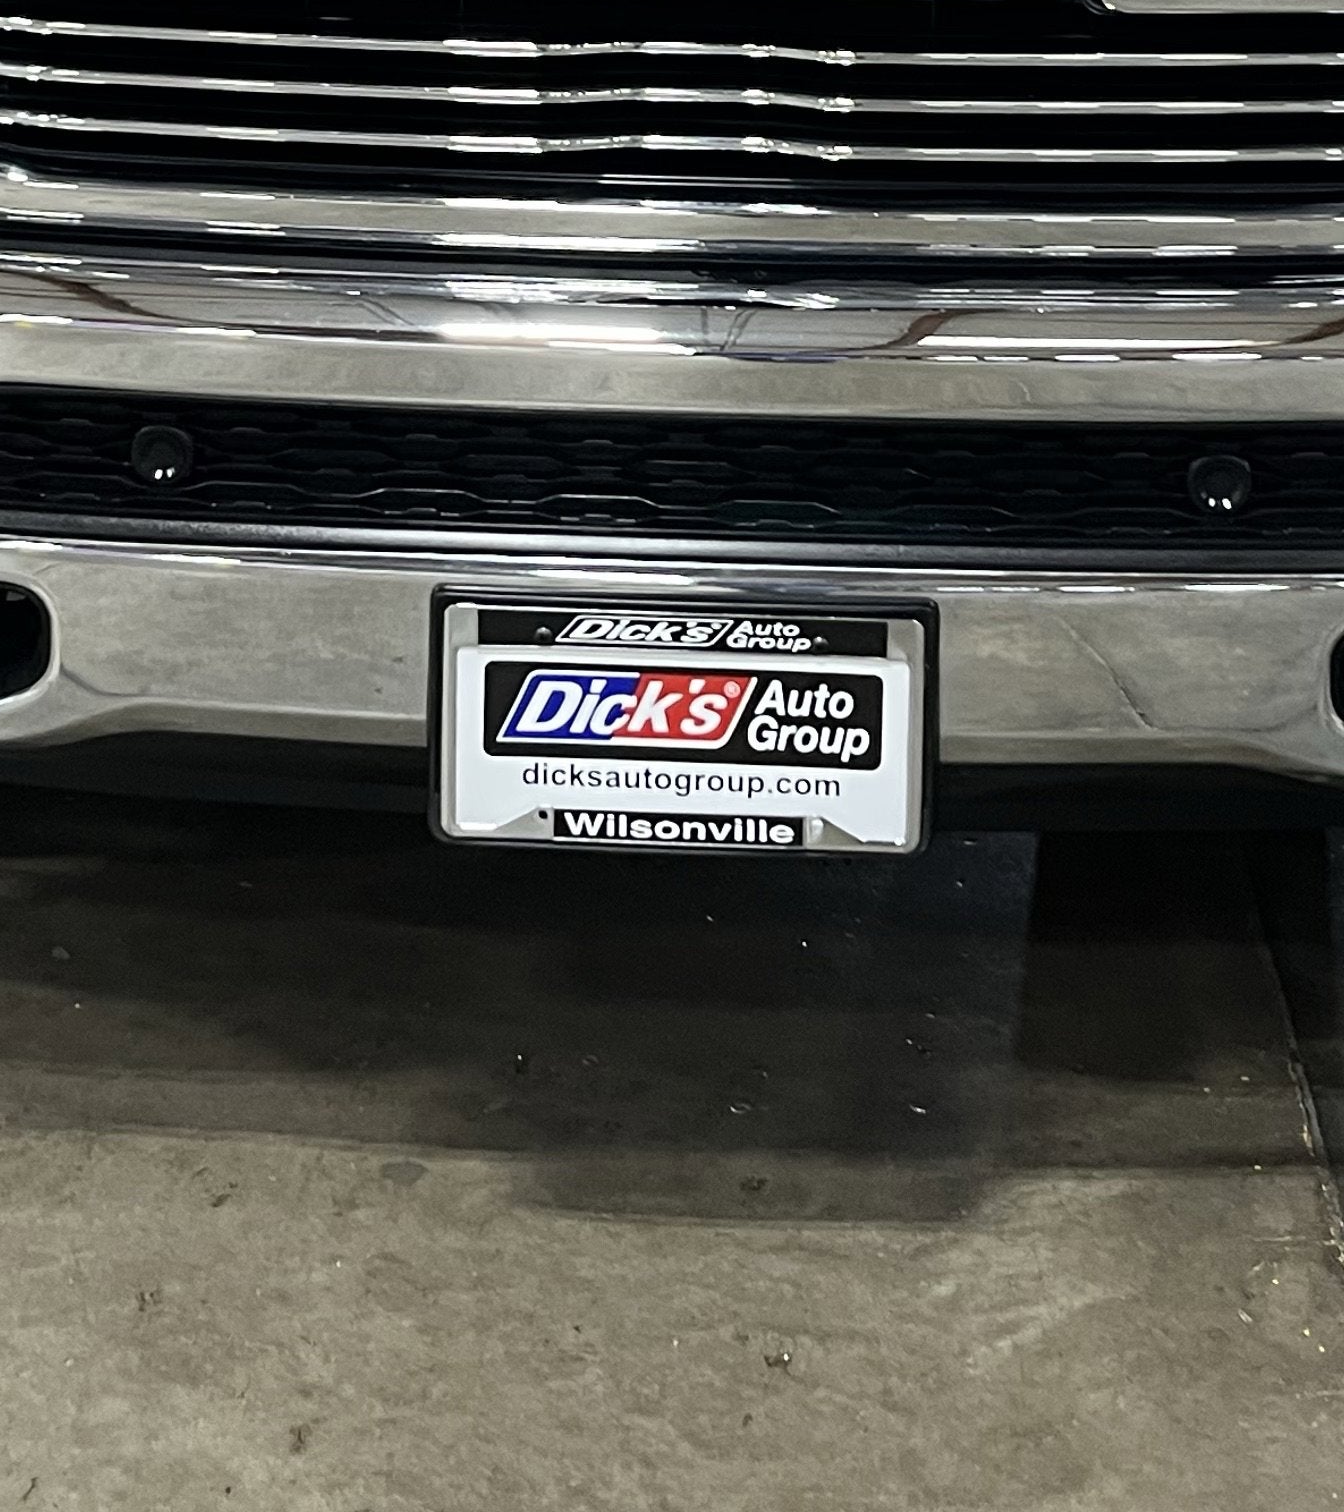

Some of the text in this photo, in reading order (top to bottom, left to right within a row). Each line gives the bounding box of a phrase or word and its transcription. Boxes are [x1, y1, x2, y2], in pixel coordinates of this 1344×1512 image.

[568, 619, 716, 643] Dick's
[726, 633, 812, 653] Group
[733, 620, 801, 637] Auto
[515, 678, 729, 736] Dick's
[755, 679, 855, 720] Auto
[747, 714, 871, 763] Group
[522, 762, 842, 799] dicksautogroup.com
[563, 811, 796, 844] Wilsonville
